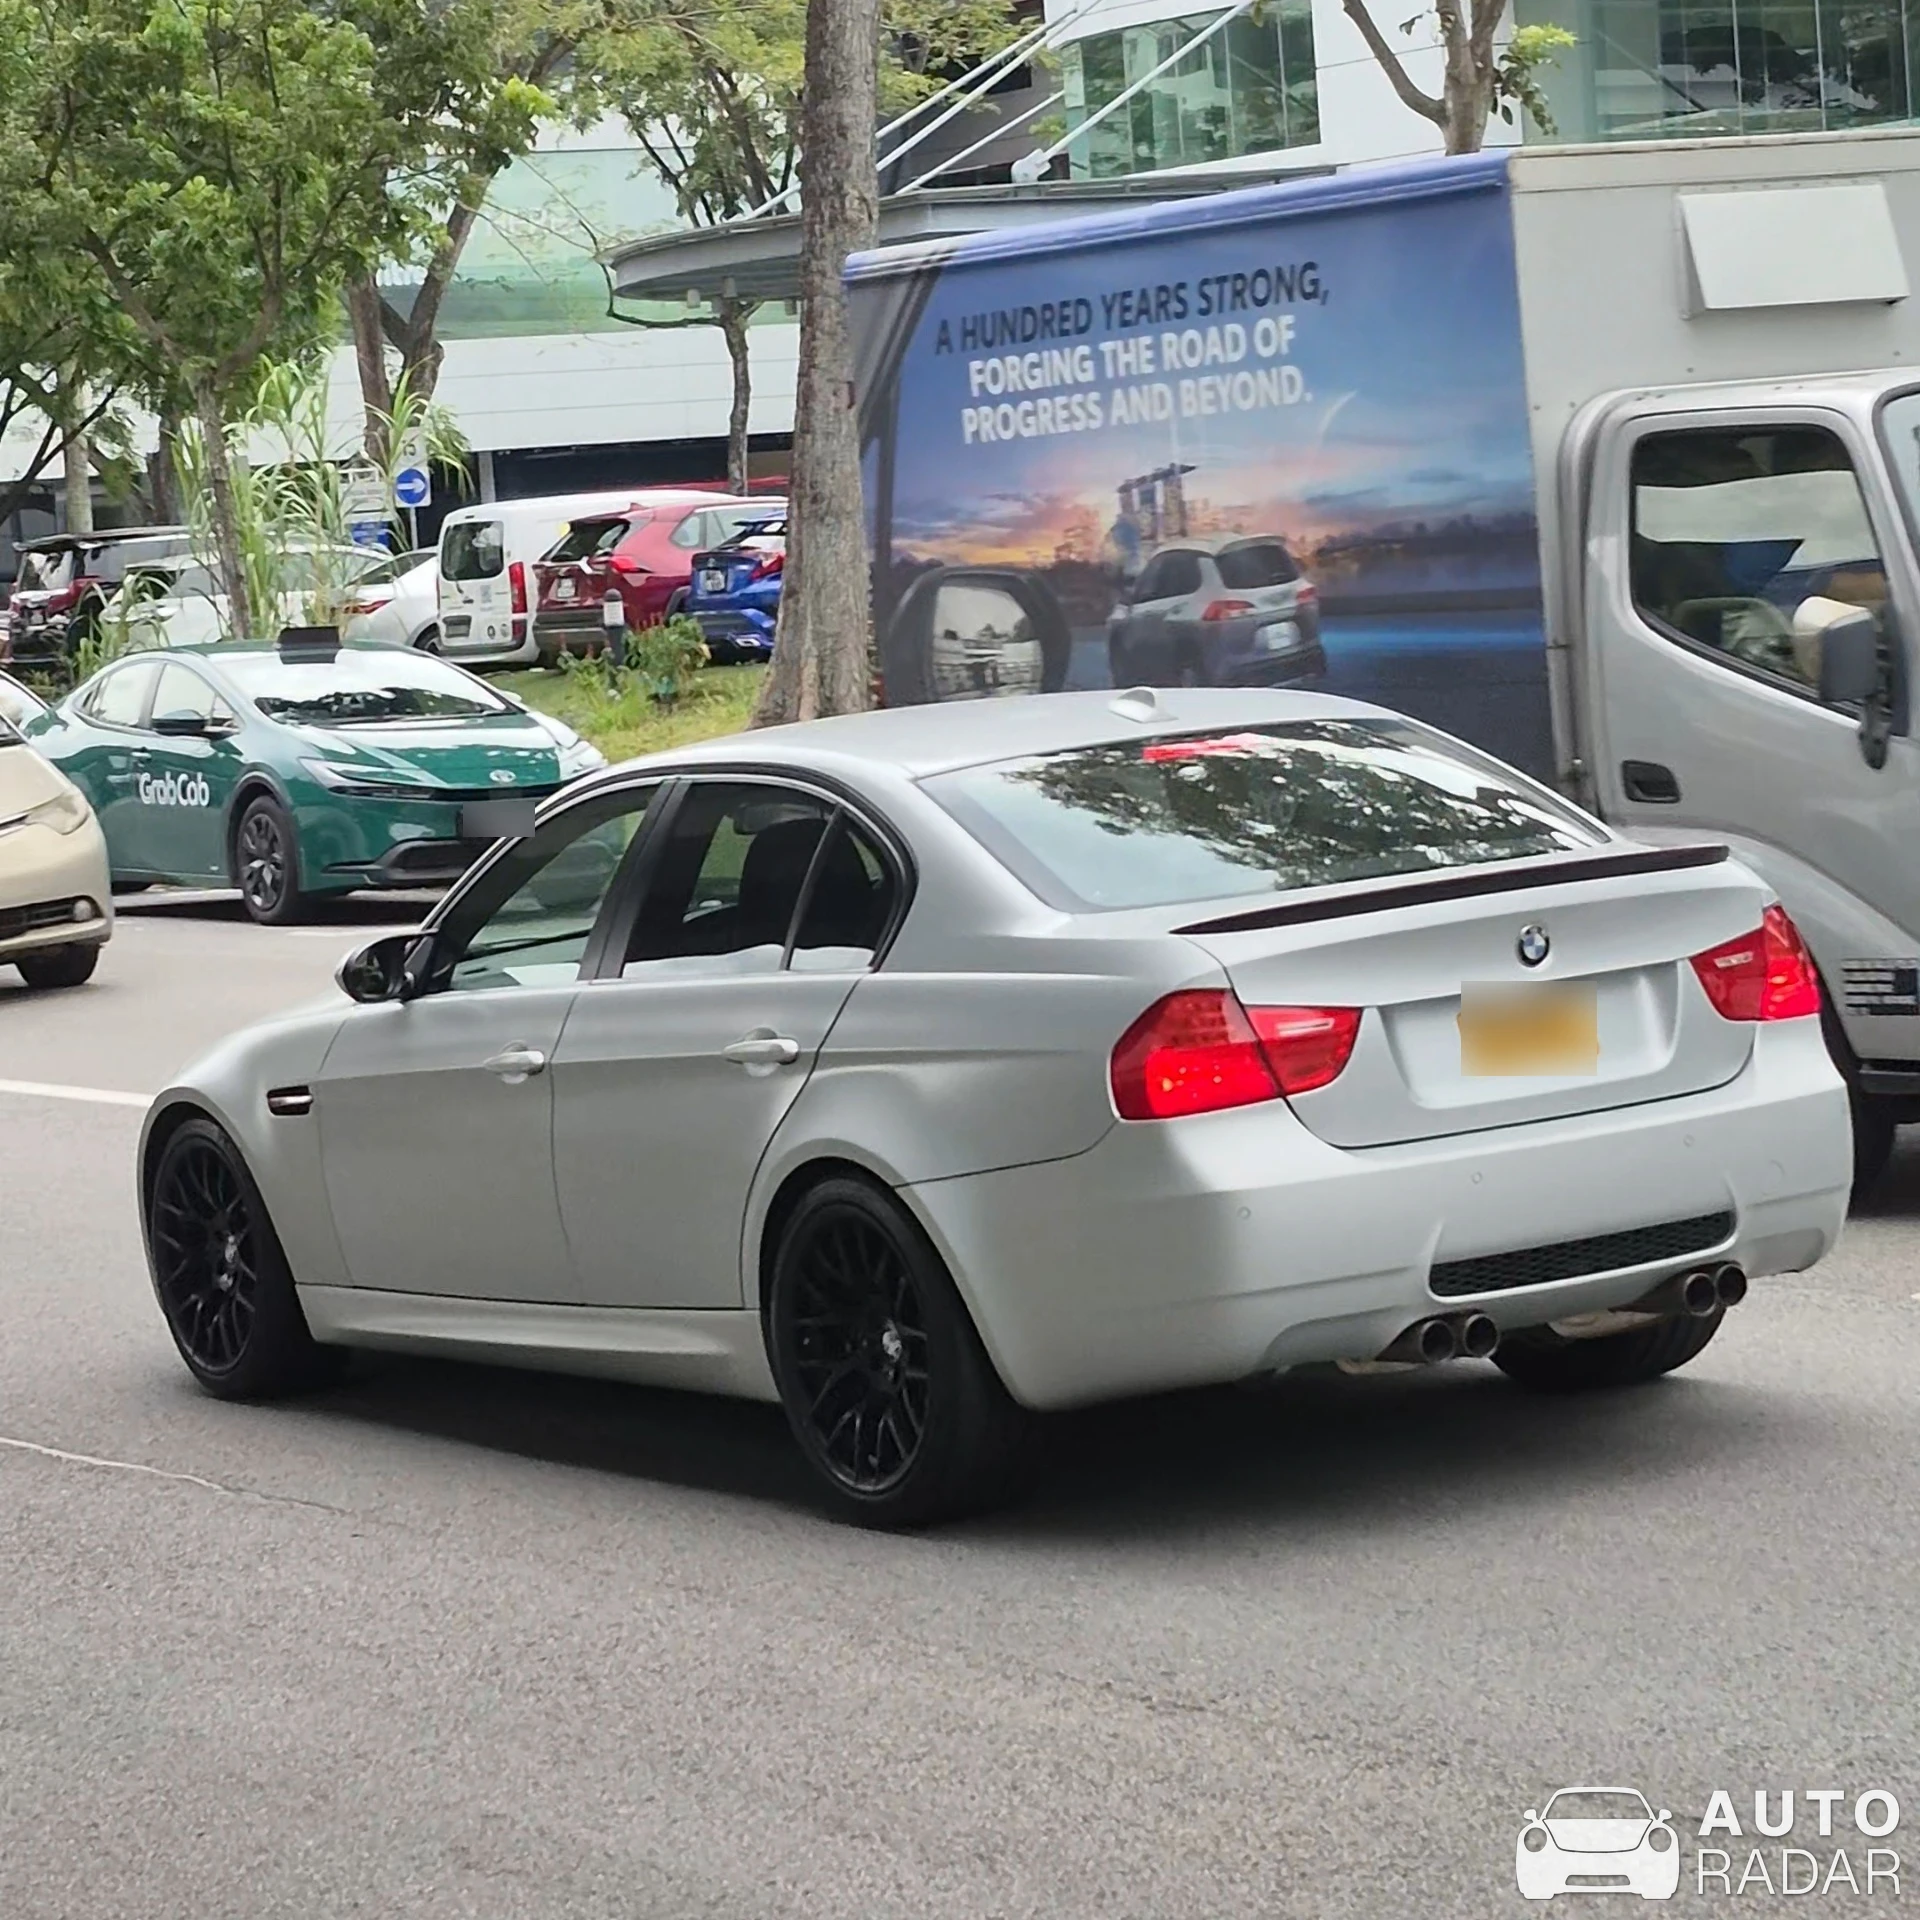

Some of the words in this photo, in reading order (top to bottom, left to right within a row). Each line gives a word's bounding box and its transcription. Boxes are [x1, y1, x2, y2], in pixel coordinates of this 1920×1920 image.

[935, 319, 954, 355] A
[961, 297, 1094, 352] HUNDRED
[1103, 281, 1189, 331] YEARS
[1198, 260, 1330, 317] STRONG,
[968, 344, 1096, 397] FORGING
[1100, 336, 1156, 379] THE
[1161, 323, 1247, 371] ROAD
[1253, 314, 1297, 359] OF
[961, 399, 1102, 444] PROGRESS
[1109, 383, 1172, 425] AND
[1179, 364, 1313, 418] BEYOND.
[139, 771, 210, 806] GrabCab
